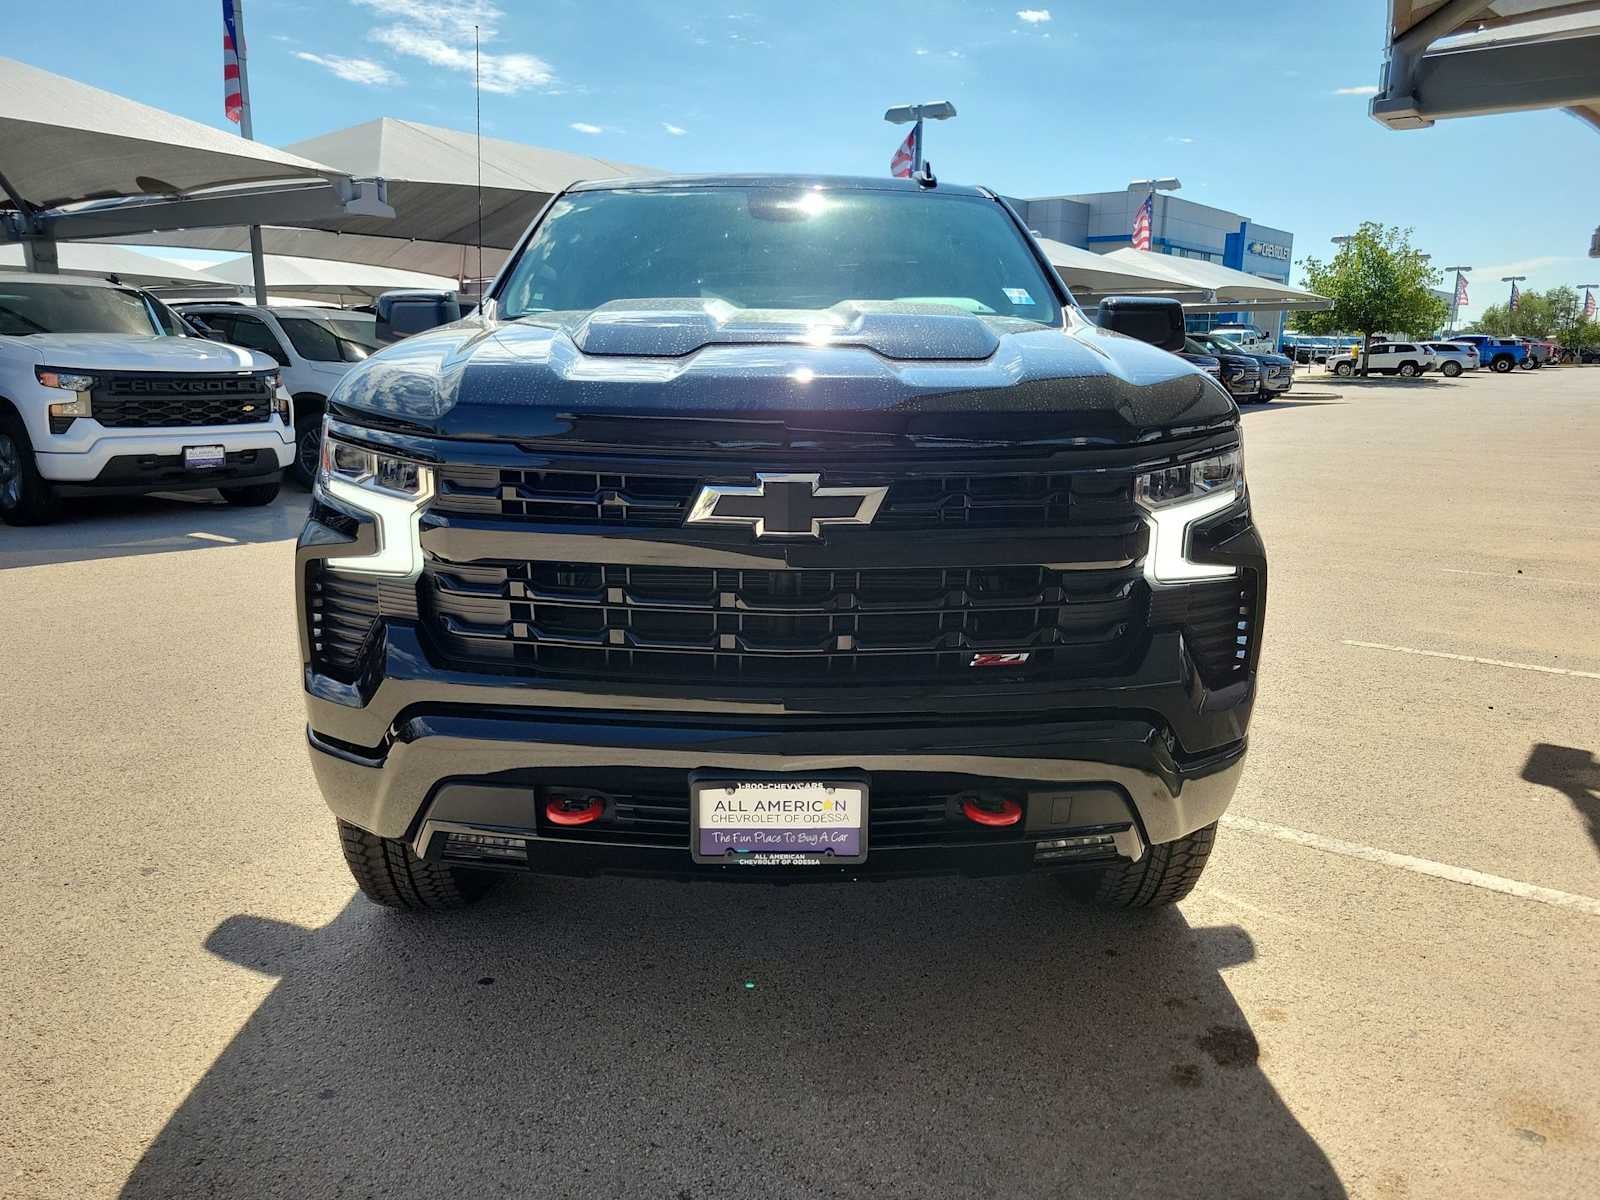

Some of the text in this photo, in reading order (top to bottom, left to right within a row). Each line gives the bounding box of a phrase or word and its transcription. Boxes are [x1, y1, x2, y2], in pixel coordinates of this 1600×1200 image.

[1261, 243, 1289, 260] CHEVROLET
[111, 380, 264, 393] CHEVROLET
[714, 800, 846, 812] ALL AMERICN
[711, 813, 850, 823] CHEVROLET OF ODESSA
[711, 831, 849, 846] The Fun Place To Buy A Car
